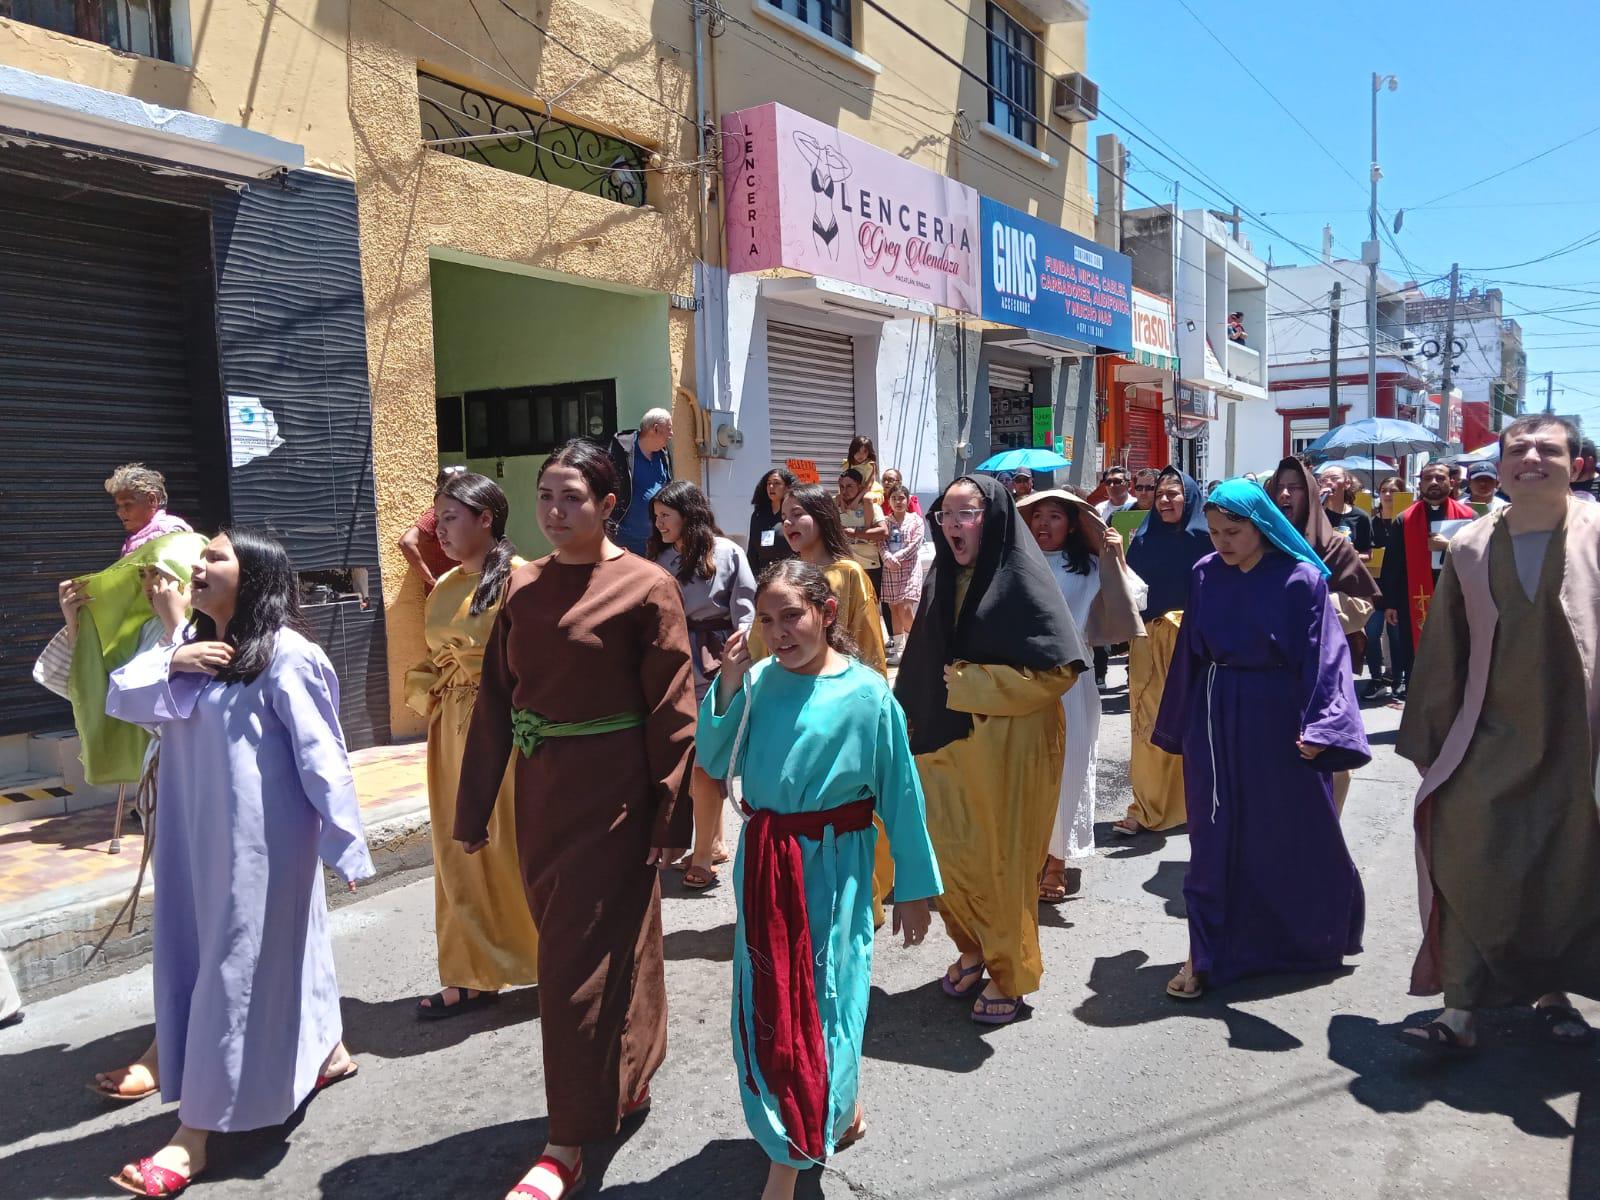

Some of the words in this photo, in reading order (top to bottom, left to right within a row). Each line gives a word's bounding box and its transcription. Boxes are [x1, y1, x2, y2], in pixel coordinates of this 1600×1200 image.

[744, 125, 759, 256] LENCERIA
[840, 182, 971, 254] LENCERIA
[904, 236, 960, 276] Mendoza
[992, 220, 1037, 301] GINS
[1044, 255, 1078, 284] FUNDAS,
[1133, 300, 1170, 352] irasol
